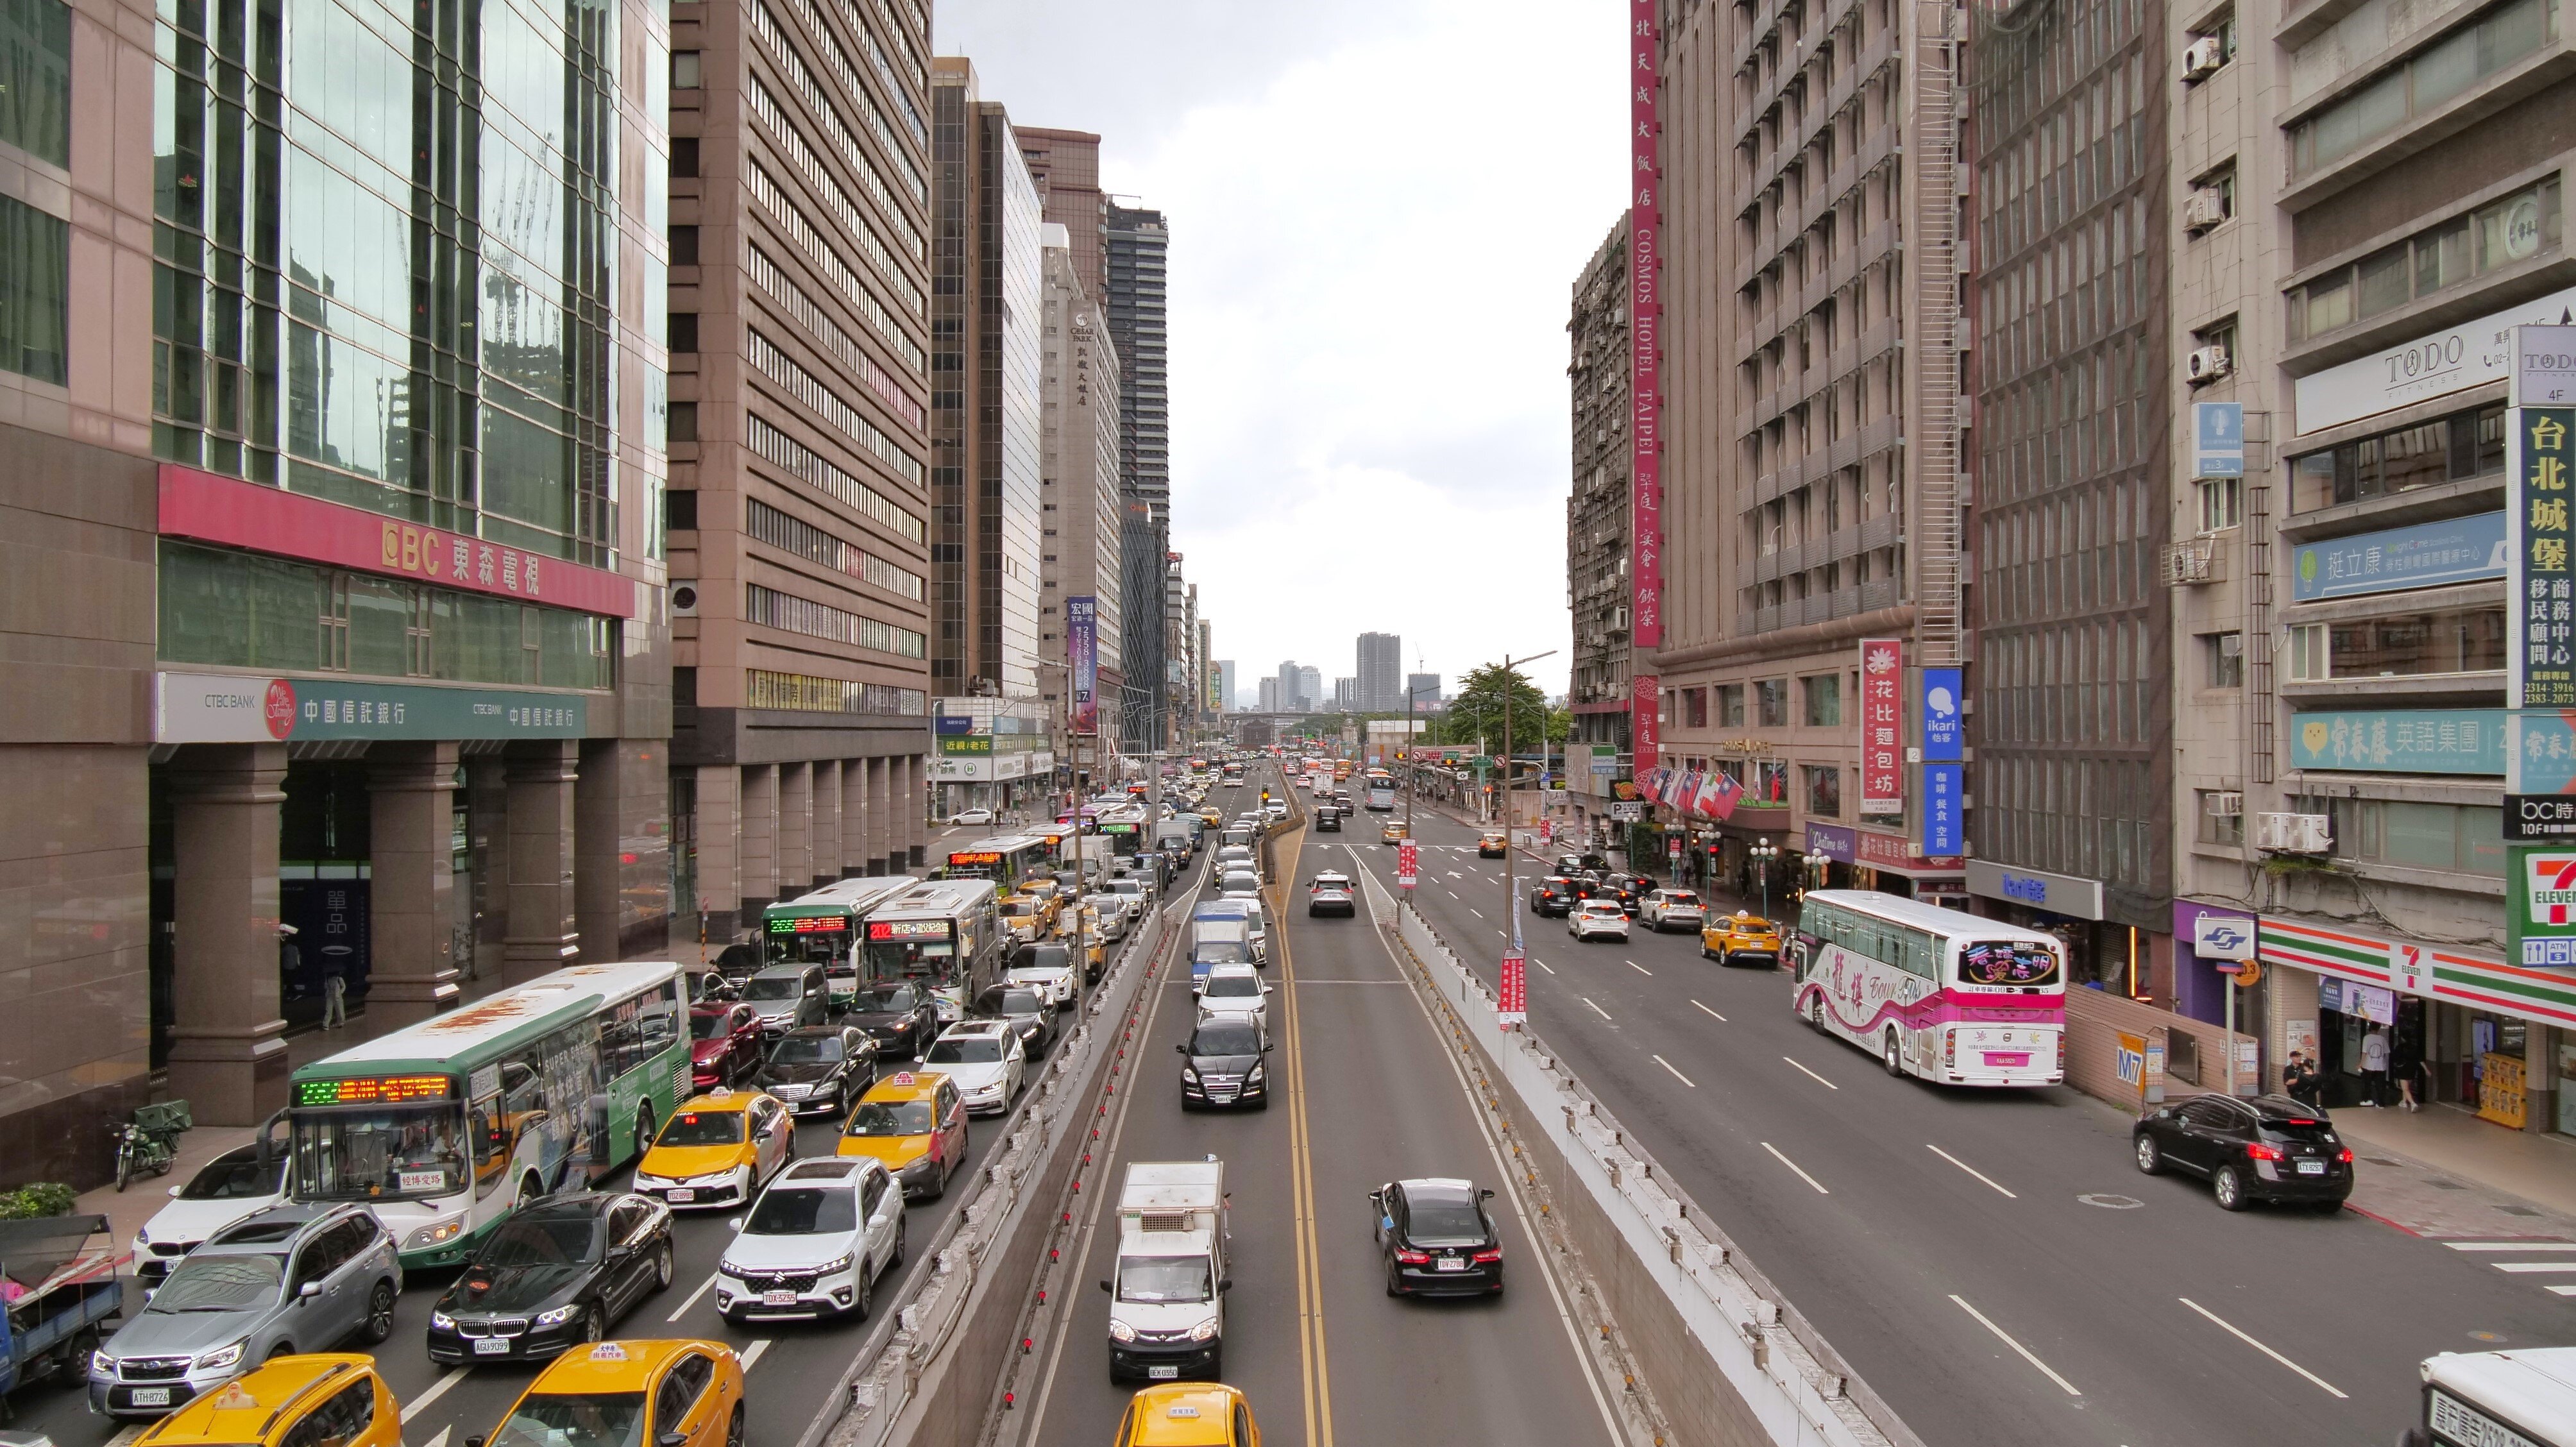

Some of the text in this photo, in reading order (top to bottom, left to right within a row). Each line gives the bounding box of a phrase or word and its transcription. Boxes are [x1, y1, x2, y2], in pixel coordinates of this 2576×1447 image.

[1635, 0, 1652, 207] 北天成大飯店
[1637, 229, 1653, 455] COSMOS HOTEL TAIPEI
[2385, 335, 2464, 384] TODO
[2388, 373, 2458, 400] FITNESS
[2548, 390, 2564, 402] 4F
[2530, 416, 2567, 571] 台北城堡
[452, 539, 539, 596] 東森電視
[2328, 546, 2382, 580] 挺立康
[1071, 603, 1094, 614] 宏國
[2530, 579, 2548, 665] 移民顧問
[2552, 579, 2570, 665] 商務中心
[2525, 683, 2574, 693] 2314-3916
[205, 695, 255, 709] CTBC BANK
[2525, 694, 2574, 704] 2383-2073
[304, 699, 405, 724] 中國信託銀行
[473, 704, 503, 716] CTBC BANK
[509, 707, 573, 727] 中國信託銀行
[1928, 720, 1955, 731] ikari
[946, 740, 989, 751] 近視/老花
[1876, 680, 1894, 793] 花比麵包坊
[1932, 733, 1951, 743] 怡客
[2396, 720, 2479, 754] 英語集團
[1912, 751, 1918, 759] 2
[1614, 804, 1622, 815] P
[2521, 798, 2576, 820] bc時
[2521, 823, 2541, 834] 10F
[1813, 831, 1836, 851] Chatime
[1915, 845, 1919, 854] 1
[326, 891, 347, 934] 單品
[870, 923, 891, 940] 202
[891, 924, 911, 935] 新店
[2402, 945, 2420, 989] 7
[546, 1050, 568, 1072] SUPER
[2118, 1046, 2143, 1086] M7
[402, 1174, 442, 1185] 經博愛路
[476, 1341, 508, 1352] AGU-9099
[133, 1392, 169, 1403] ATH-8726
